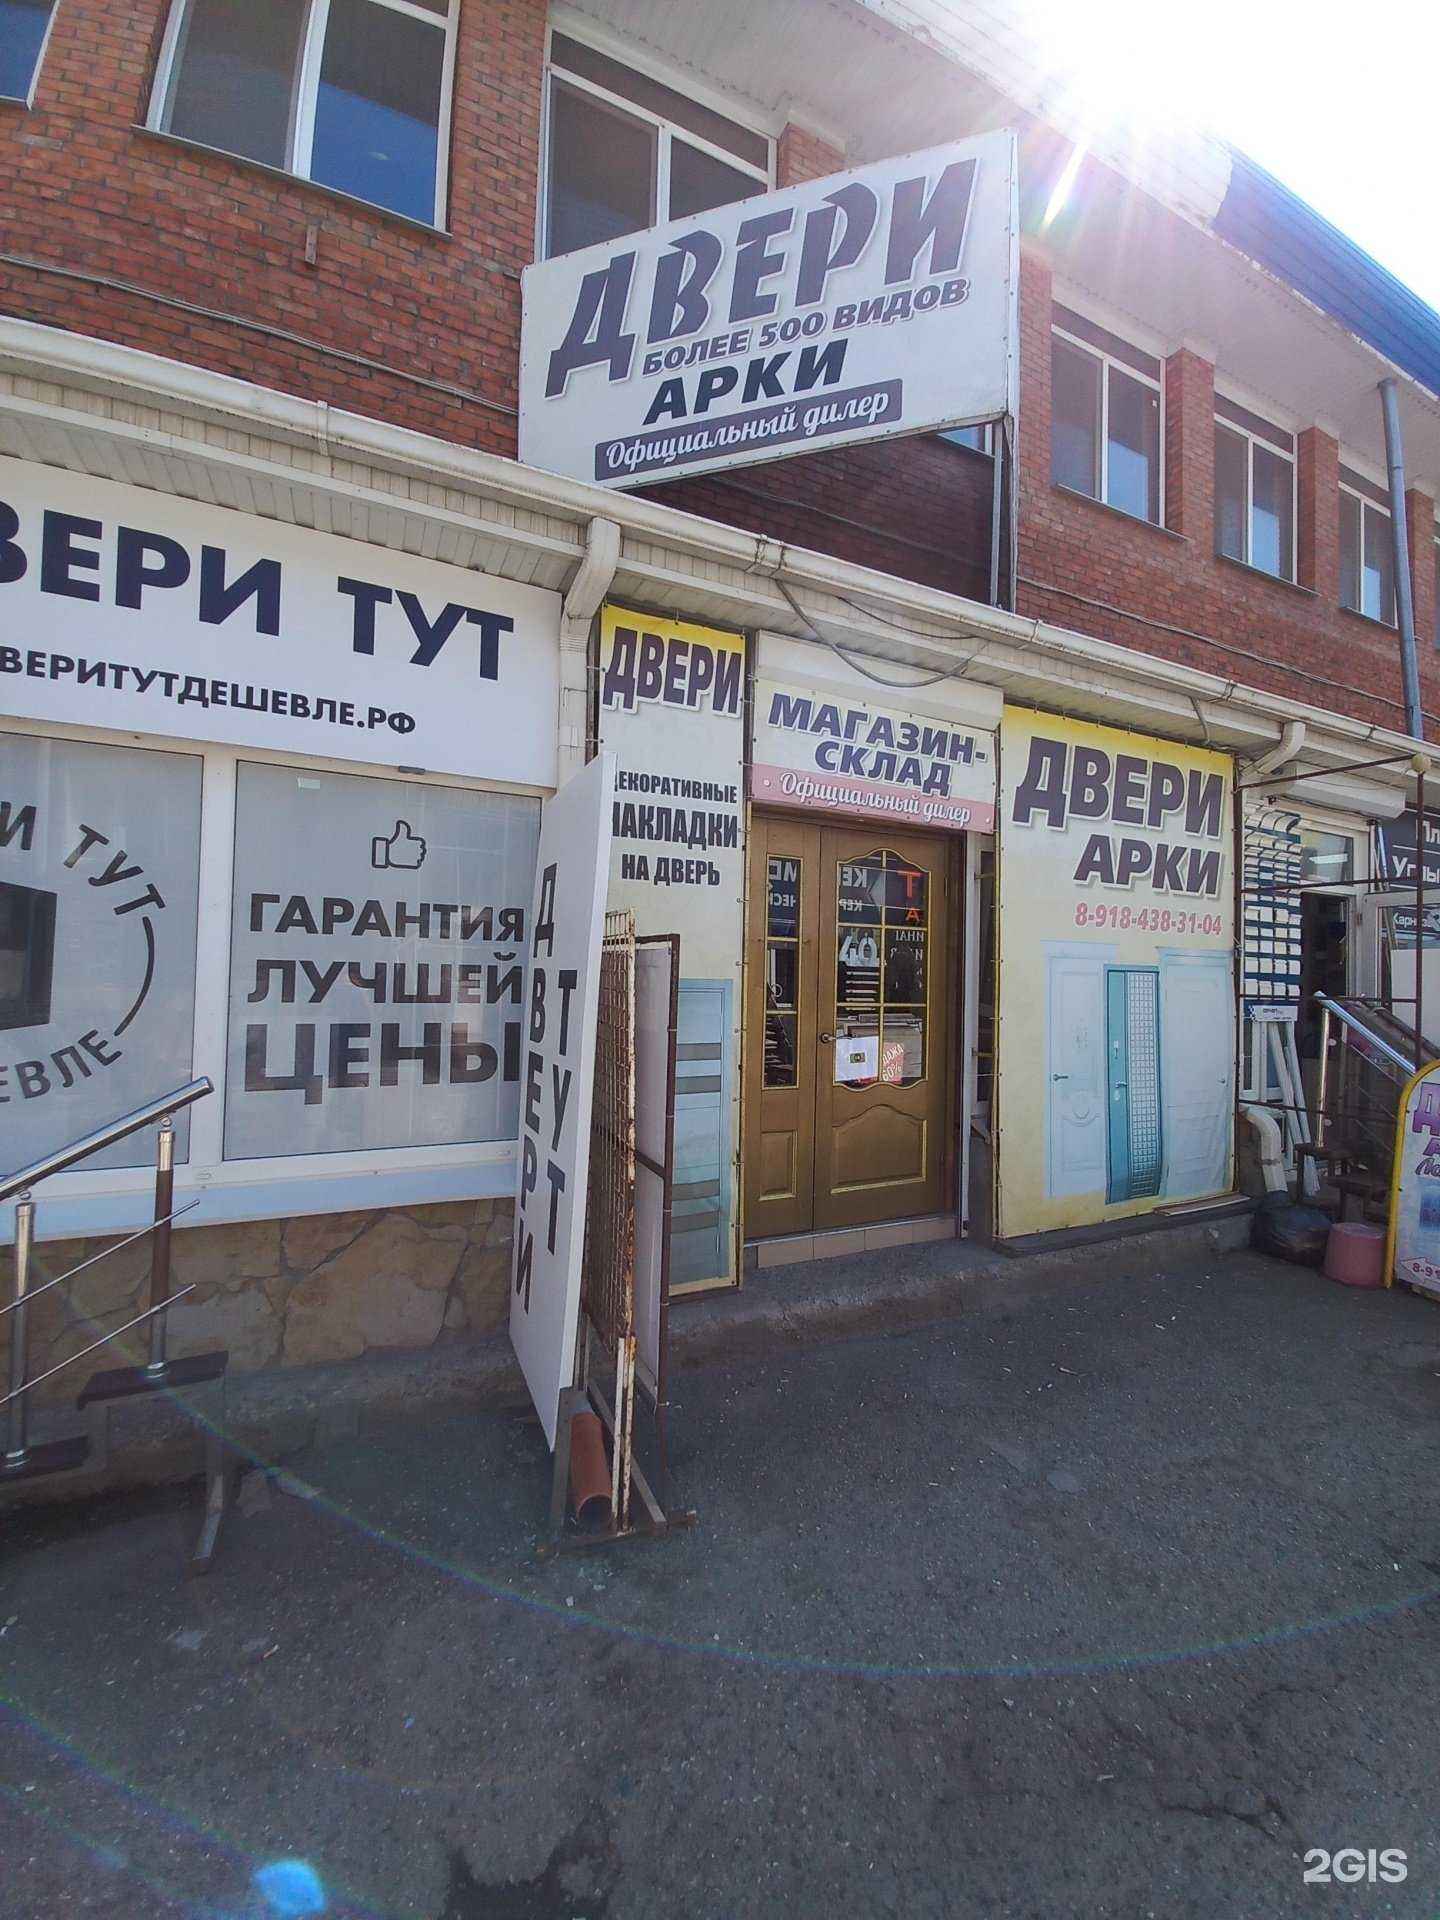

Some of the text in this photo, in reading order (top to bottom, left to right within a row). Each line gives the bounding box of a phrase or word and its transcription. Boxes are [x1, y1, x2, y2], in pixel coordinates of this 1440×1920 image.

[544, 157, 978, 399] ДВЕРИ
[642, 278, 970, 376] БОЛЕЕ 500 ВИДОВ
[642, 338, 849, 426] АРКИ
[606, 389, 890, 471] Официальный дилер
[337, 575, 514, 681] ТУТ
[0, 646, 416, 735] ВЕРИТУТДЕШЕВЛЕ.РФ
[602, 626, 742, 715] ДВЕРИ
[768, 692, 987, 764] МАГАЗИН-
[815, 740, 953, 797] СКЛАД
[614, 770, 738, 804] ЕКОРАТИВНЫЕ
[780, 772, 971, 827] Официальный дилер
[1012, 736, 1224, 838] ДВЕРИ
[63, 822, 166, 916] ТУТ
[622, 853, 721, 887] НА ДВЕРЬ
[1073, 833, 1221, 896] АРКИ
[249, 893, 525, 943] ГАРАНТИЯ
[1075, 902, 1222, 936] 8-918-438-31-04
[247, 951, 523, 1005] ЛУЧШЕЙ
[244, 1022, 521, 1105] ЦЕНЫ
[515, 862, 578, 1316] ДВЕРИ ТУТ
